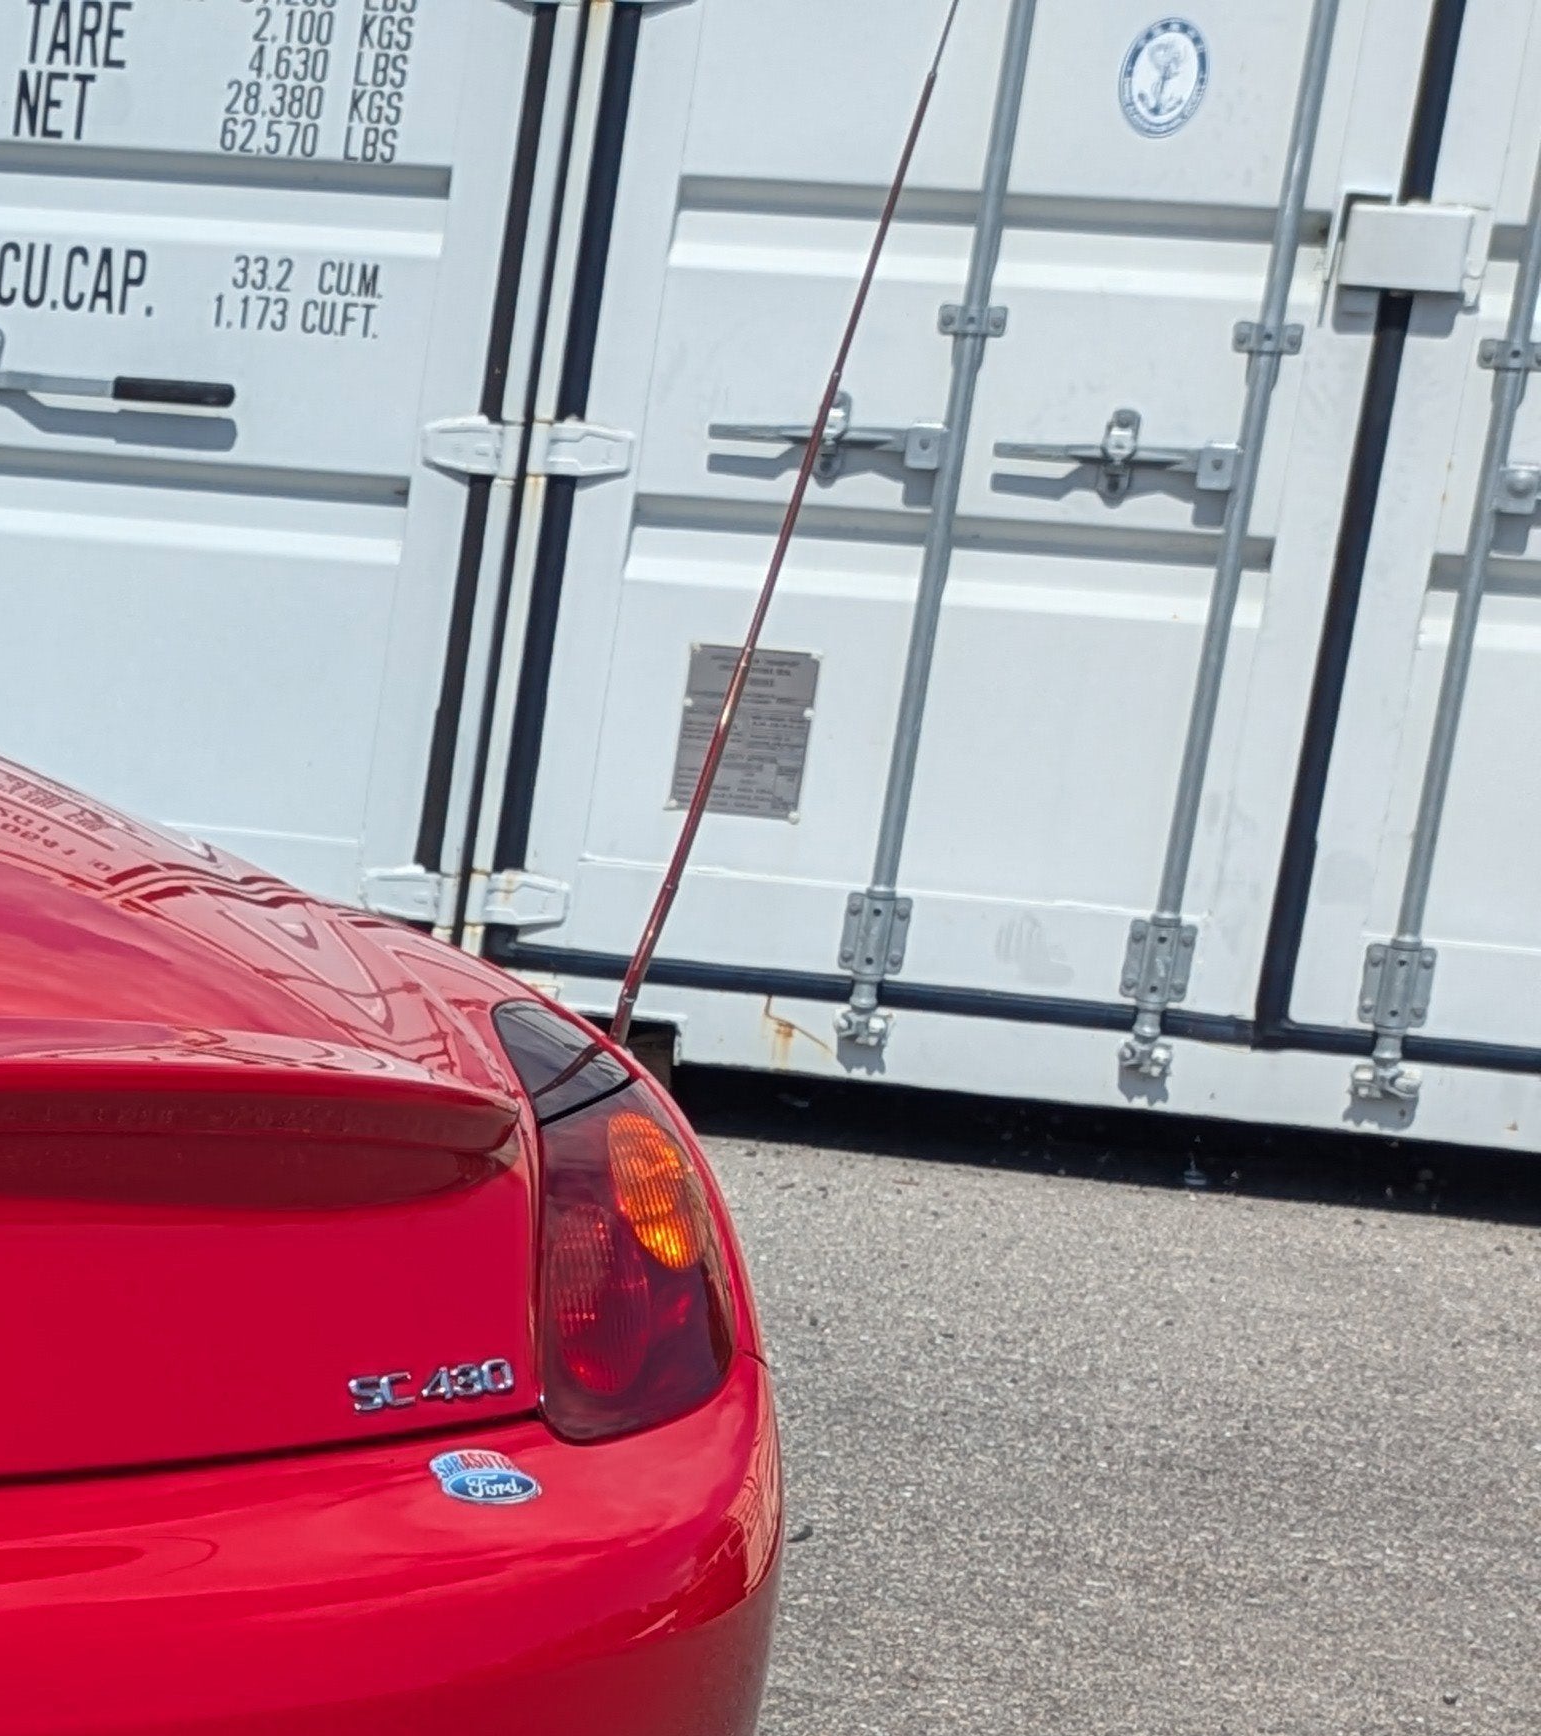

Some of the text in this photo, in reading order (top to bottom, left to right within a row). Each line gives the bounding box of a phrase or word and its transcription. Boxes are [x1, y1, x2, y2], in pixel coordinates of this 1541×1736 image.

[26, 0, 132, 68] TARE
[359, 14, 414, 51] KGS
[354, 52, 408, 88] LBS
[13, 69, 97, 140] NET
[349, 89, 404, 126] KGS
[343, 127, 398, 164] LBS
[232, 254, 294, 292] 33.2
[348, 1358, 515, 1412] SC 430
[435, 1451, 517, 1479] SARASOTA
[465, 1473, 523, 1498] Ford
